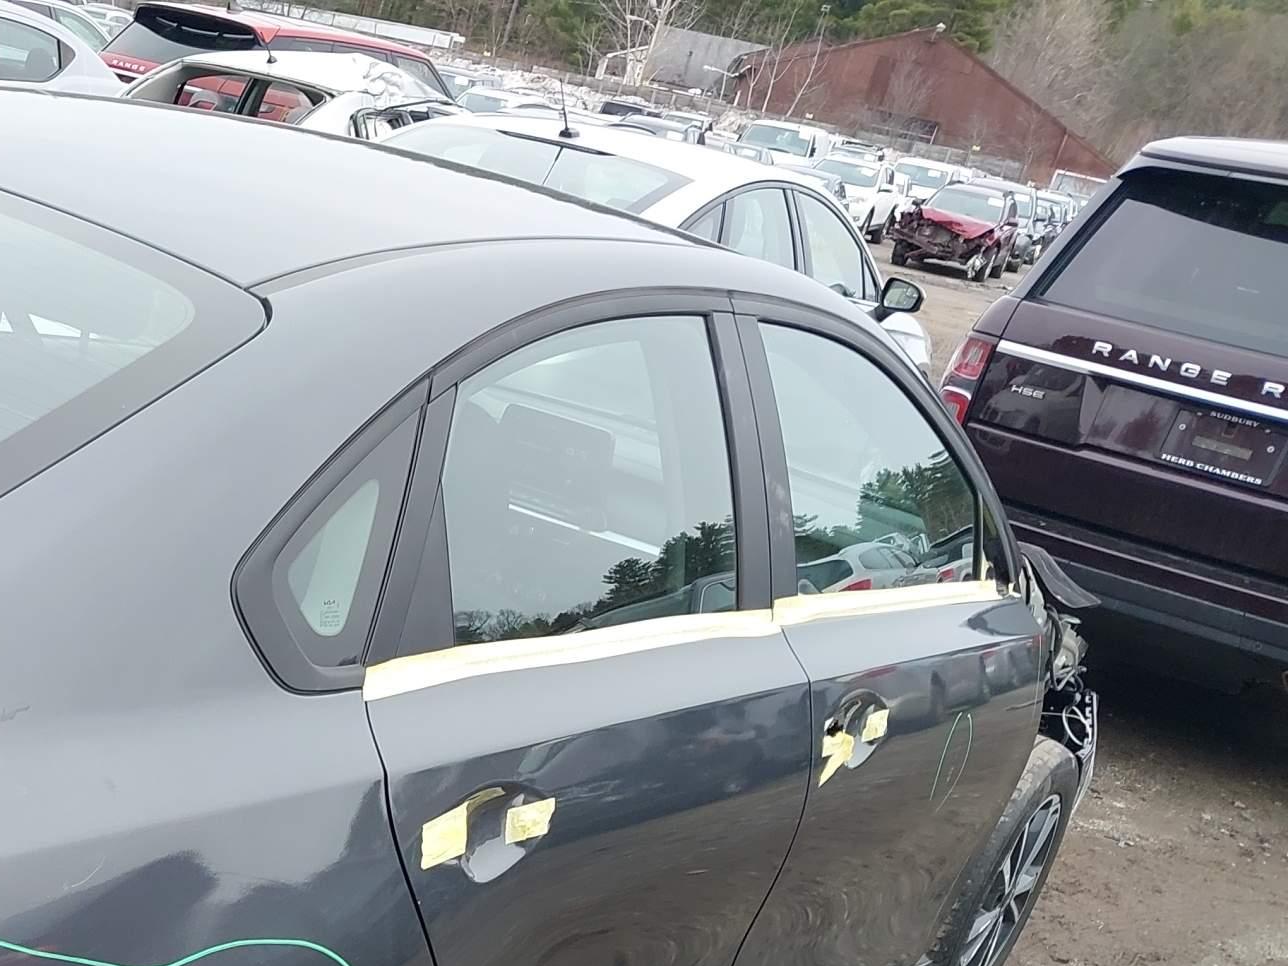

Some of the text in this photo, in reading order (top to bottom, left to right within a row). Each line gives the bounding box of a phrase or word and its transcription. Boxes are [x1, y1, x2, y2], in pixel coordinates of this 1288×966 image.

[1091, 341, 1232, 386] RANGE
[1011, 384, 1045, 400] HSE
[1210, 410, 1261, 428] SUDBURY
[1161, 453, 1263, 486] HERB CHAMBERS
